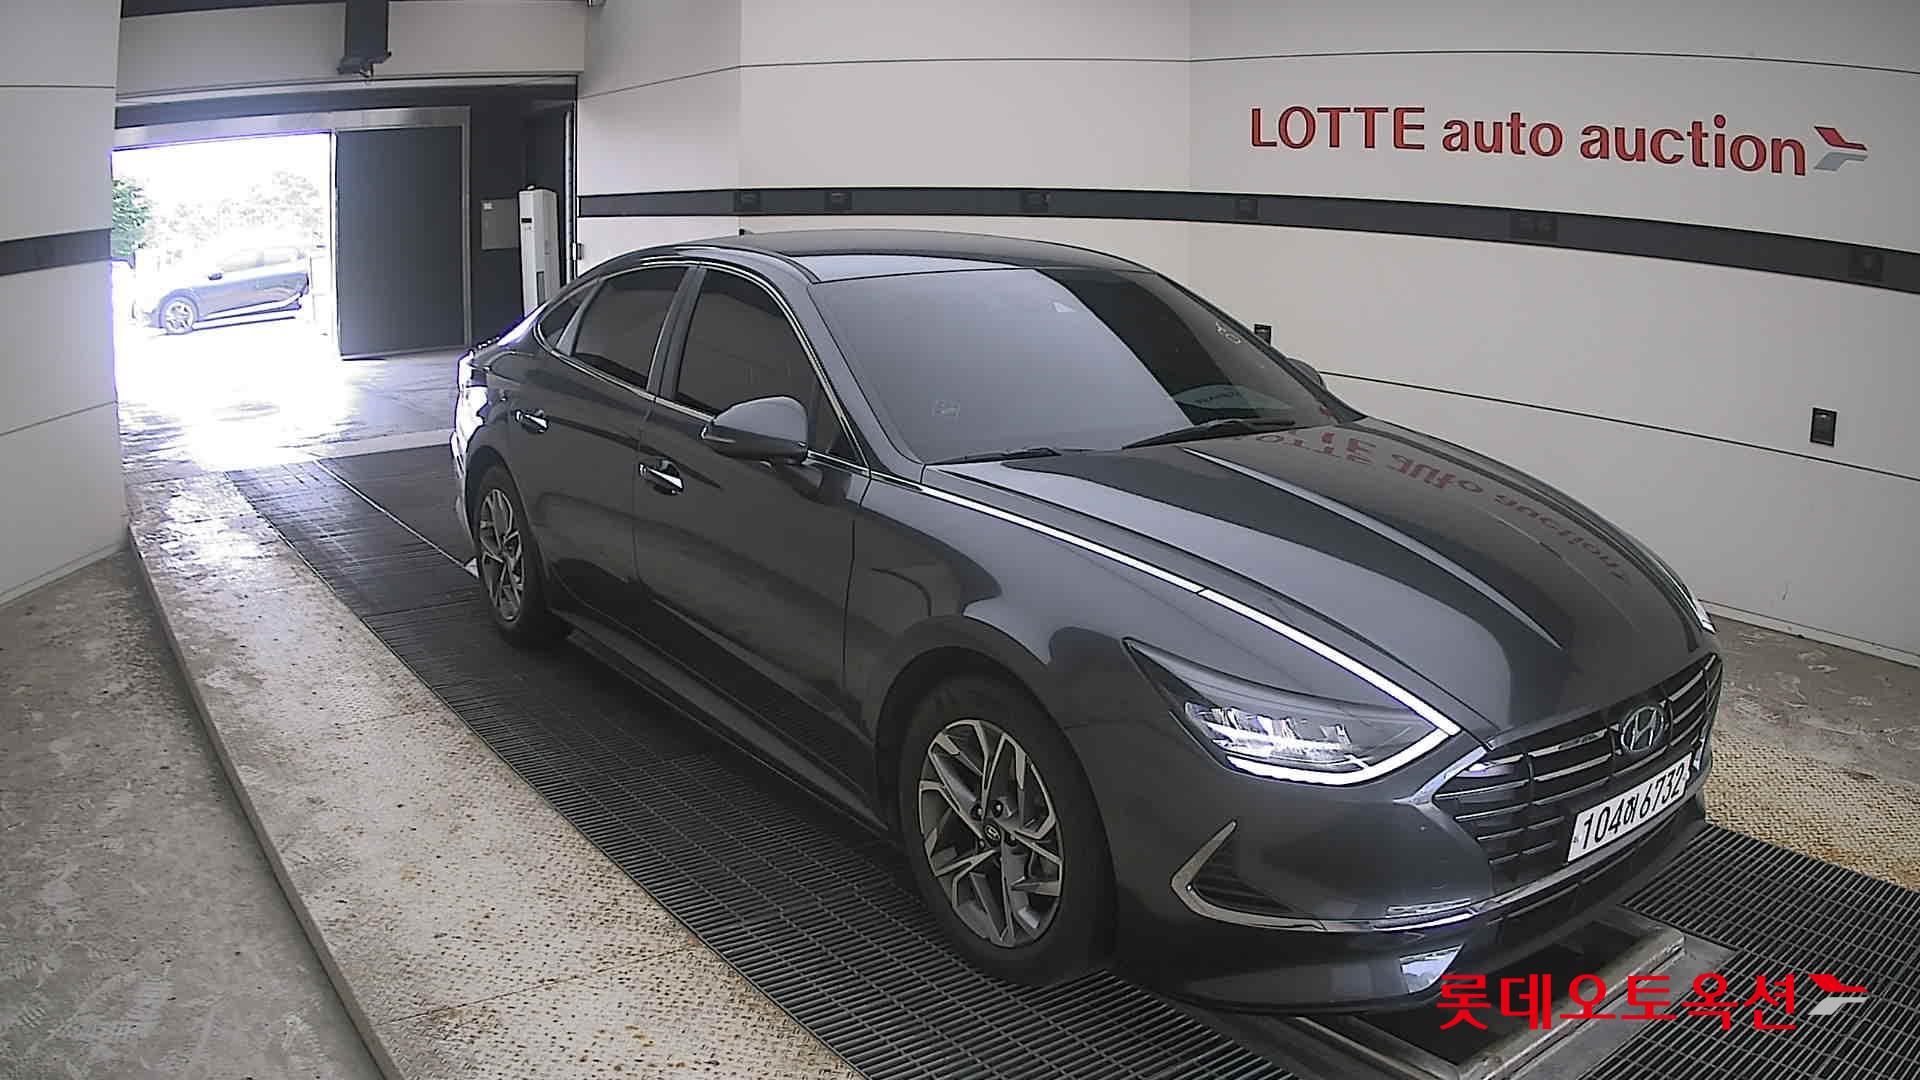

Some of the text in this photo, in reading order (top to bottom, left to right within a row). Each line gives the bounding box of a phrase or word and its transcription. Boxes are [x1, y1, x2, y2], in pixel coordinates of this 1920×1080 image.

[1250, 106, 1808, 176] LOTTE auto auction
